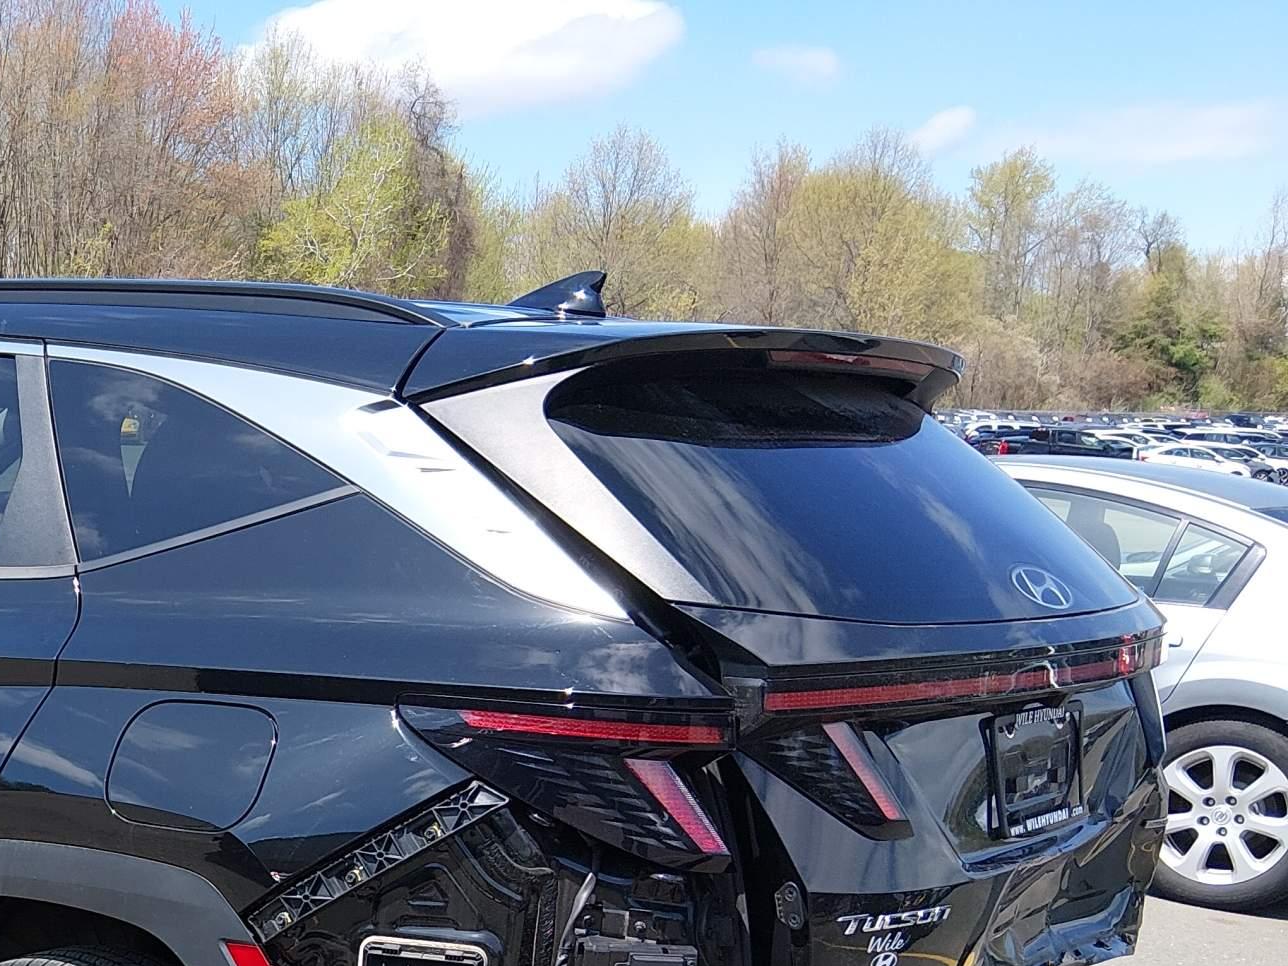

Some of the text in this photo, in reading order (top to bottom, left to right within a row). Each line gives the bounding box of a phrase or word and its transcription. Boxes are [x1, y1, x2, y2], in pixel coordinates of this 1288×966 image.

[1034, 706, 1065, 723] HYUNDAI
[836, 905, 952, 935] TUCSON
[866, 931, 906, 954] Wile
